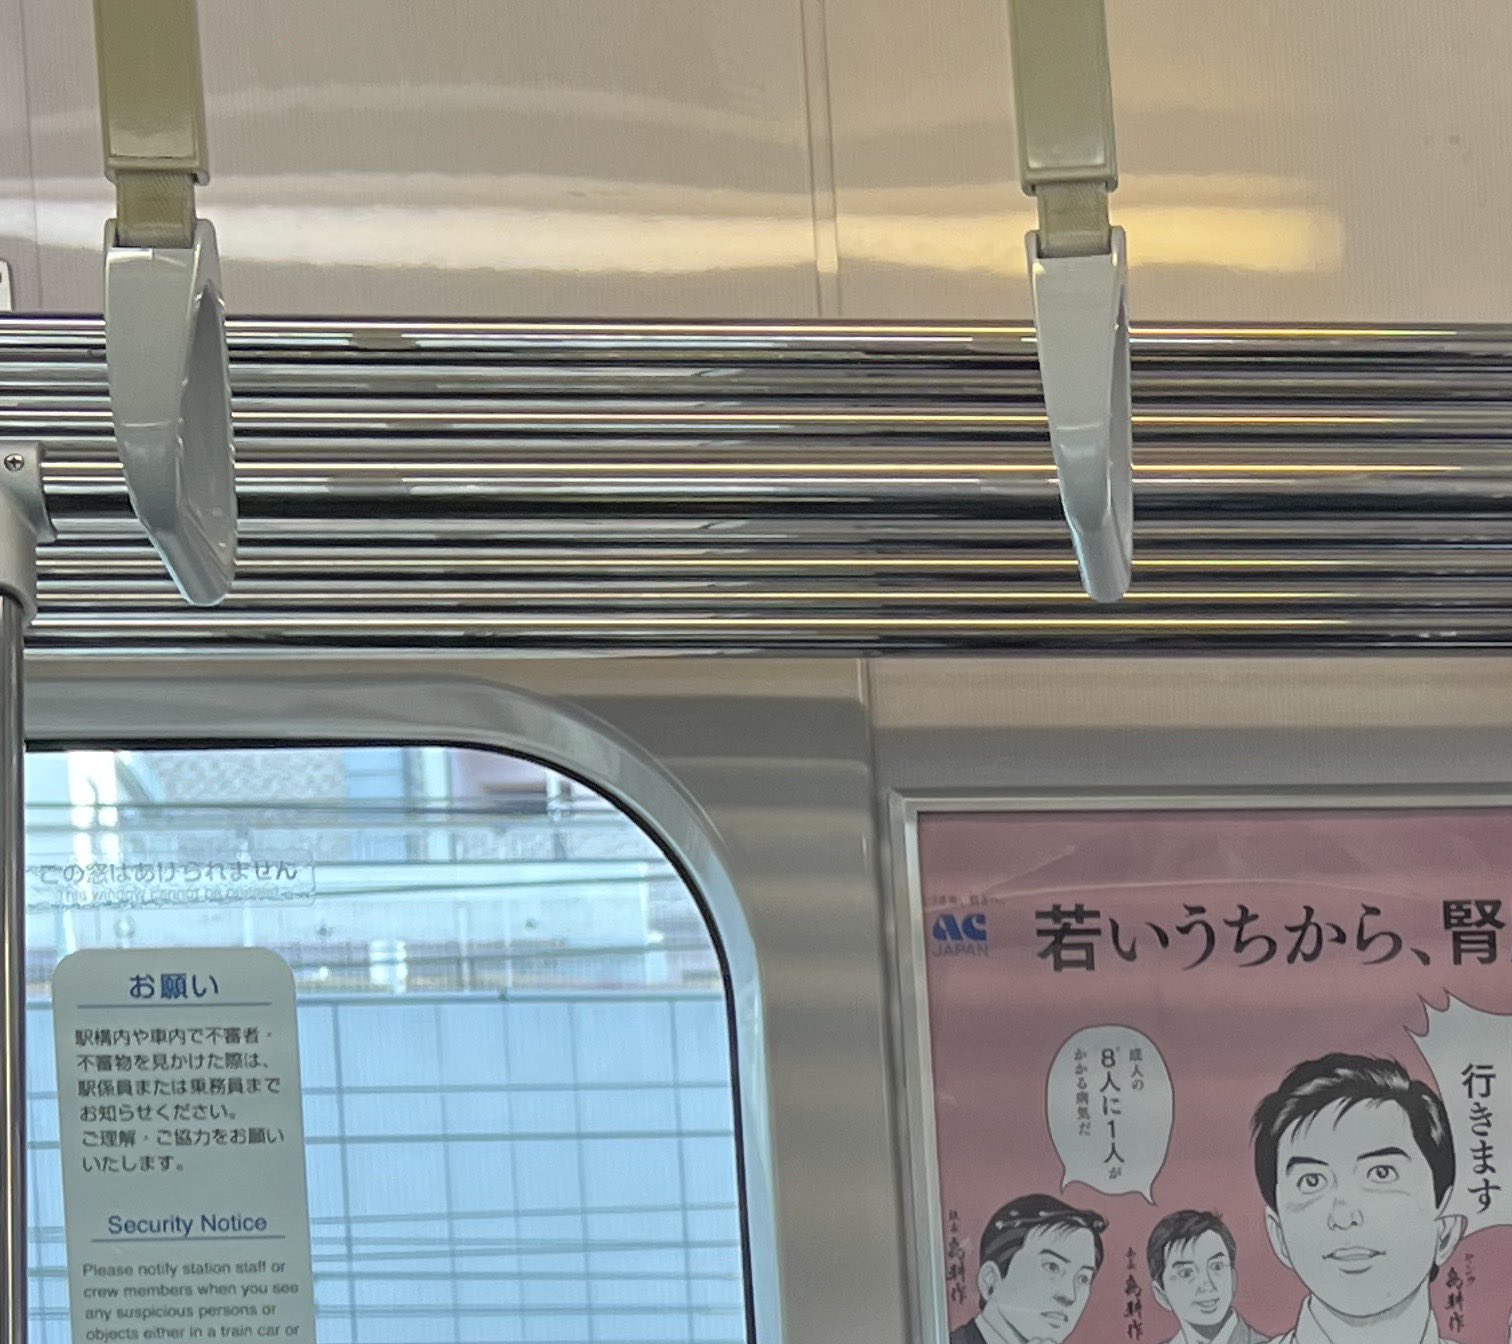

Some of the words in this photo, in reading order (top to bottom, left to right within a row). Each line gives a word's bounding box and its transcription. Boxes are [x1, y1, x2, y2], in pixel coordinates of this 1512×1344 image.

[932, 913, 987, 942] AC
[933, 942, 989, 957] JAPAN
[129, 973, 220, 999] お願い
[76, 1051, 270, 1072] 不審物を見かけた際は、
[78, 1077, 281, 1098] 駅係員または乗務員まで
[1074, 1048, 1091, 1137] かかる病気だ
[80, 1103, 236, 1123] お知らせください。
[82, 1127, 285, 1148] ご理解・ご協力をお願い
[1461, 1063, 1501, 1214] 行きます
[82, 1155, 184, 1173] いたします。
[108, 1214, 194, 1238] Security
[201, 1213, 268, 1232] Notice
[82, 1263, 133, 1277] Please
[138, 1262, 178, 1279] notify
[182, 1260, 231, 1276] station
[235, 1259, 267, 1275] staff
[271, 1261, 286, 1273] or
[83, 1286, 119, 1298] crew
[123, 1284, 194, 1298] members
[197, 1282, 237, 1296] when
[241, 1284, 269, 1298] you
[272, 1283, 300, 1294] see
[85, 1308, 112, 1322] any
[116, 1305, 194, 1321] suspicious
[198, 1304, 258, 1320] persons
[262, 1304, 277, 1316] or
[86, 1327, 139, 1343] objects
[143, 1325, 185, 1340] either
[189, 1325, 203, 1338] in
[207, 1327, 217, 1338] a
[220, 1325, 254, 1338] train
[257, 1325, 281, 1337] car
[285, 1324, 300, 1337] or
